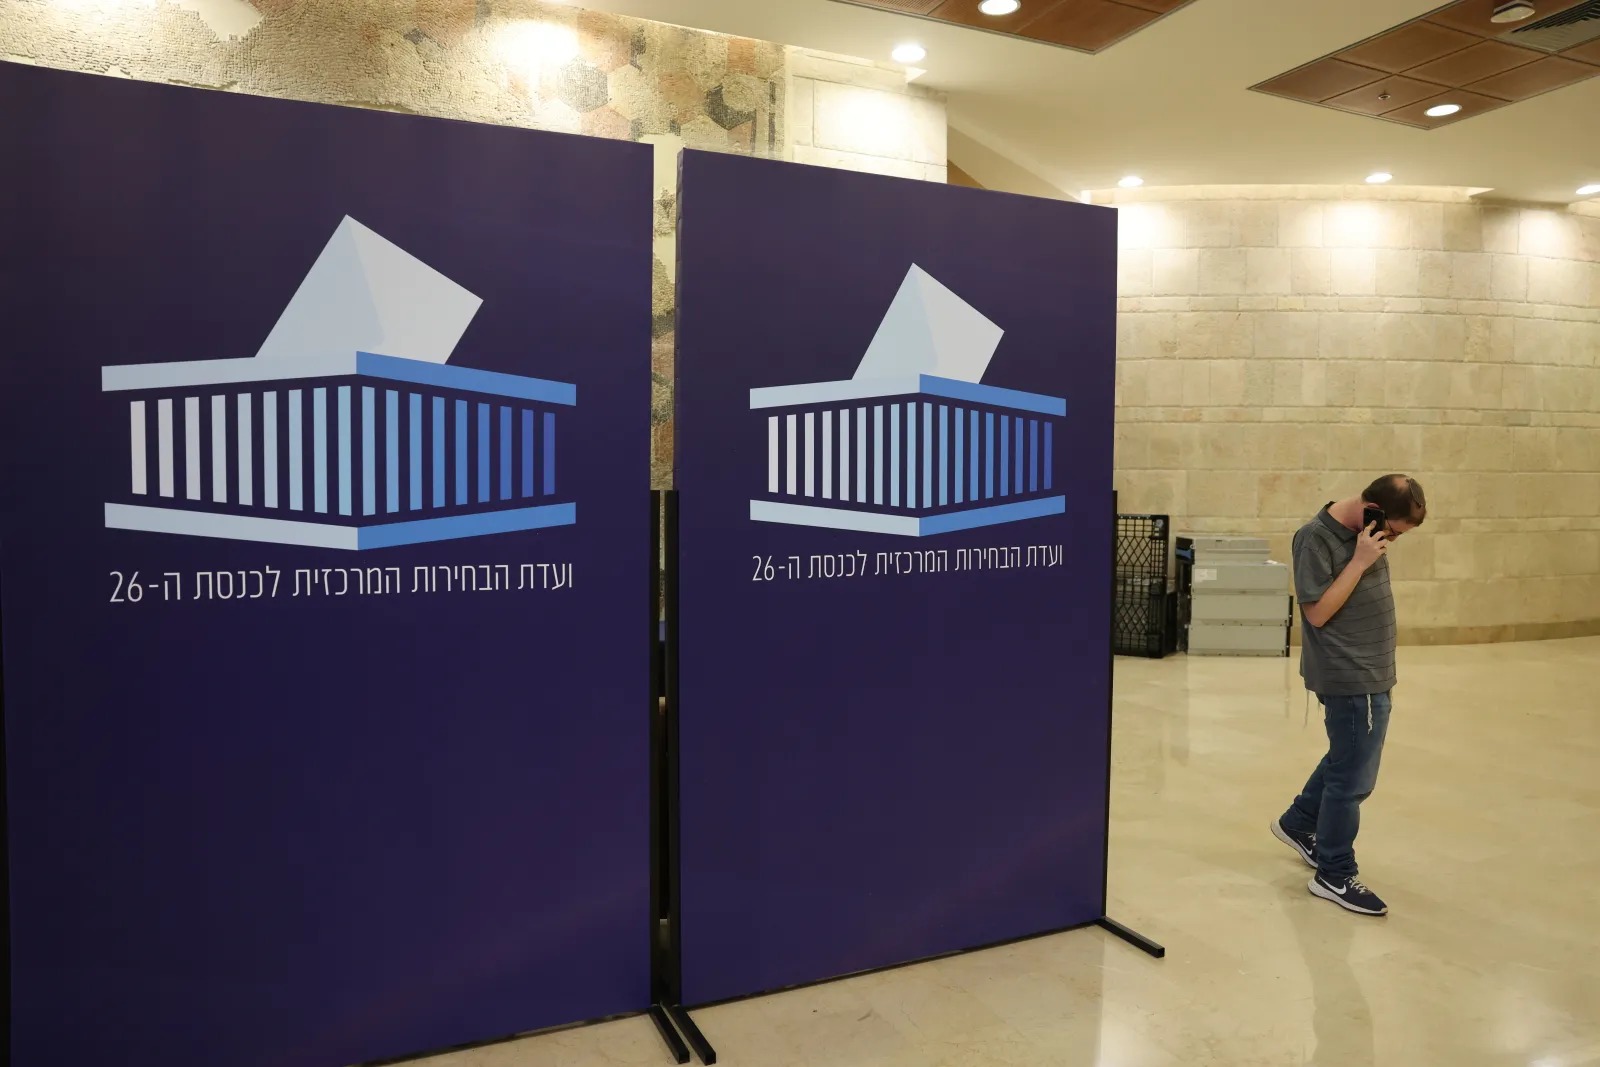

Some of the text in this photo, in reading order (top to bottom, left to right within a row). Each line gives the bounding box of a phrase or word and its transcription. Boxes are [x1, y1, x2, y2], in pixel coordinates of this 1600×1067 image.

[807, 549, 868, 579] לכנסת
[874, 549, 948, 576] המרכזית
[954, 546, 1021, 571] הבחירות
[1025, 544, 1063, 568] ועדת
[193, 565, 281, 600] לכנסת
[292, 567, 401, 597] המרכזית
[411, 564, 509, 593] הבחירות
[517, 563, 573, 591] ועדת
